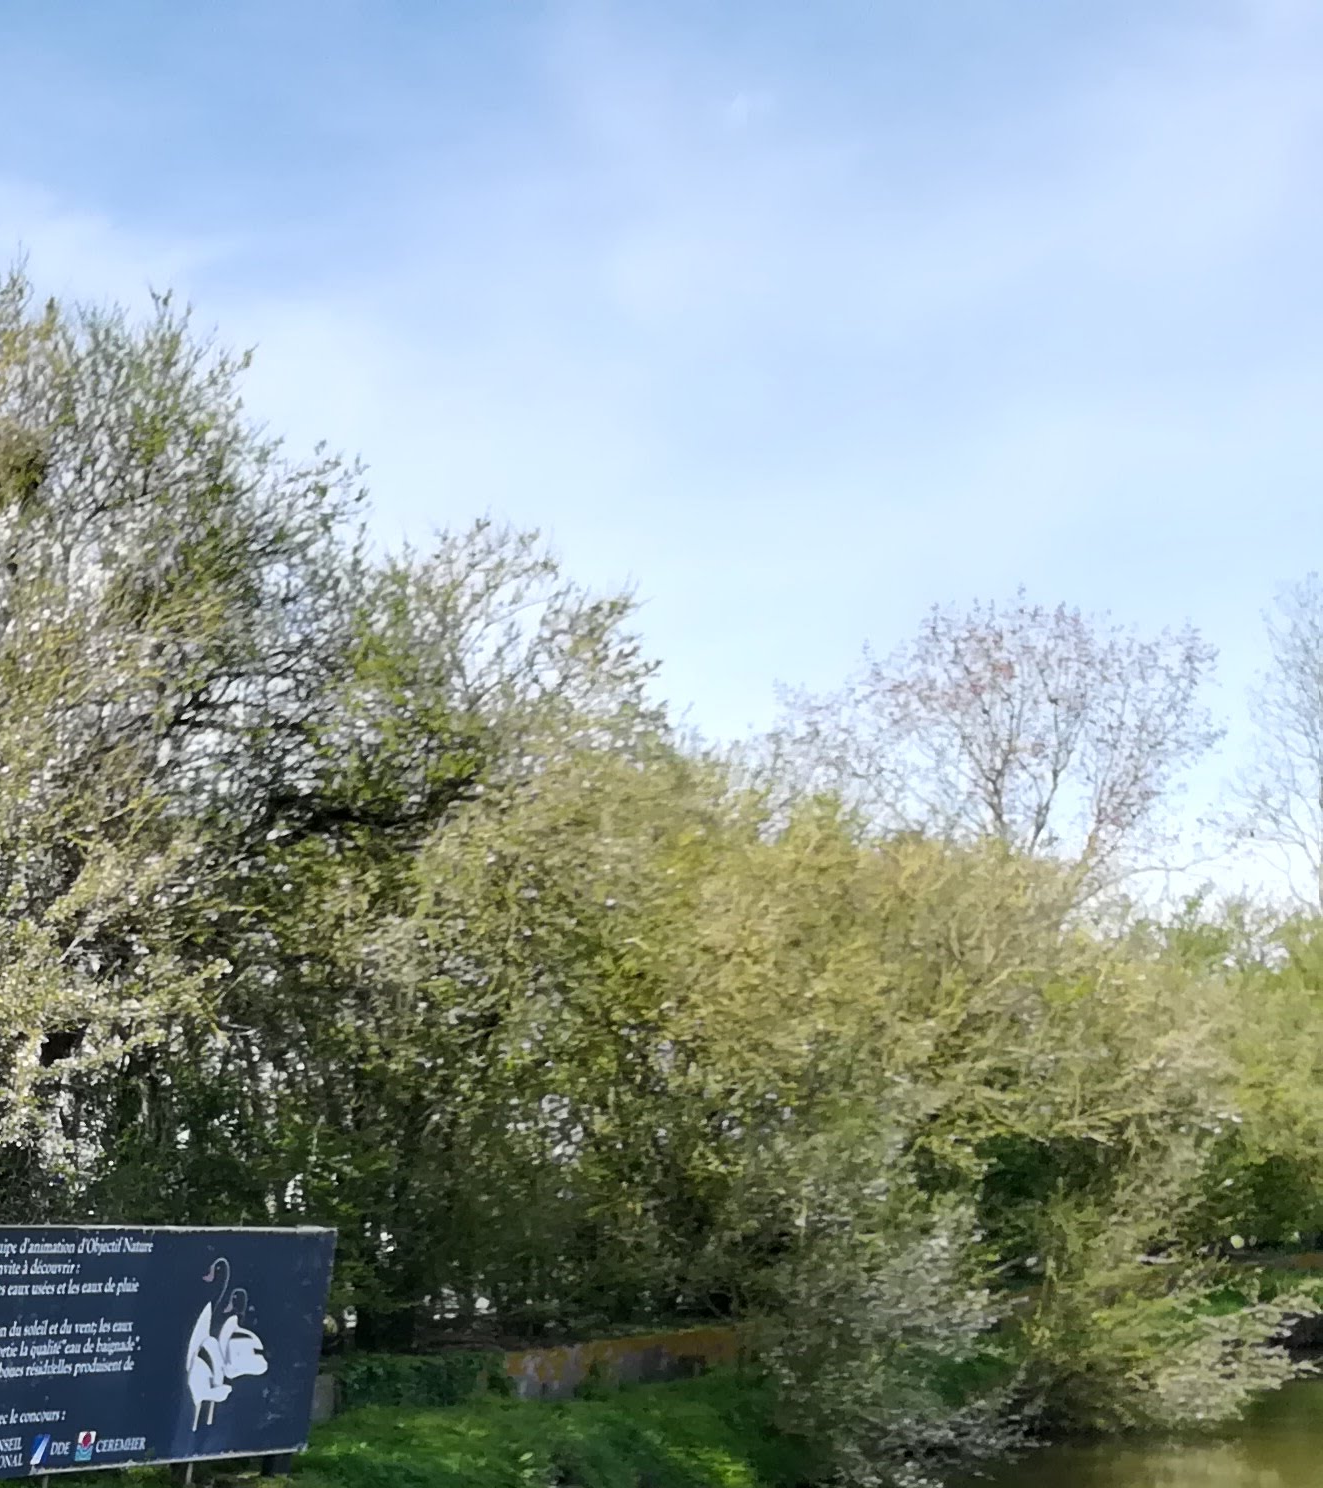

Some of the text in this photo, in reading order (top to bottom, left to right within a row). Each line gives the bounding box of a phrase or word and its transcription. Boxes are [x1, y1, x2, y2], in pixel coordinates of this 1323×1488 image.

[20, 1237, 75, 1254] d'animation
[78, 1237, 123, 1256] d'Objectif
[123, 1237, 153, 1253] Nature
[21, 1260, 29, 1275] à
[7, 1285, 30, 1296] eaux
[31, 1280, 55, 1295] usées
[56, 1282, 67, 1295] et
[67, 1278, 80, 1295] les
[81, 1282, 103, 1293] eaux
[104, 1277, 116, 1293] de
[116, 1277, 140, 1296] pluie
[9, 1320, 22, 1337] du
[23, 1319, 49, 1336] soleil
[49, 1322, 59, 1335] et
[59, 1318, 73, 1334] du
[98, 1317, 111, 1333] les
[112, 1321, 134, 1333] eaux
[19, 1340, 29, 1357] la
[83, 1337, 95, 1354] de
[73, 1357, 123, 1377] produisent
[123, 1355, 135, 1371] de
[9, 1408, 19, 1424] le
[50, 1441, 71, 1455] DDE
